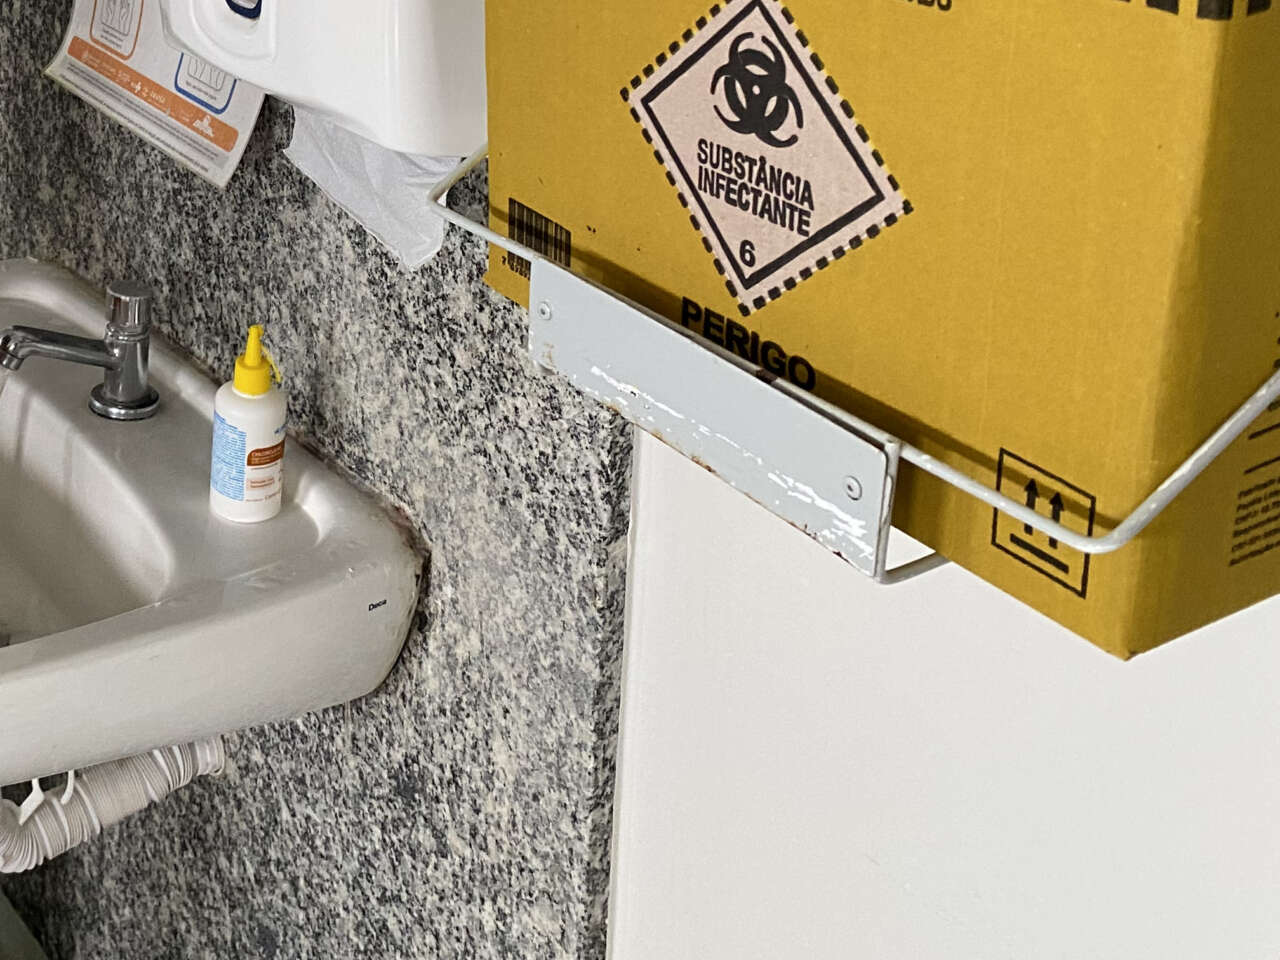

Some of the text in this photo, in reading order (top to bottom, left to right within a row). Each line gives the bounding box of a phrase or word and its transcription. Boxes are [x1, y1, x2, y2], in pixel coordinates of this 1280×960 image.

[696, 138, 815, 212] SUBSTÂNCIA
[697, 165, 812, 237] INFECTANTE
[739, 239, 756, 268] 6
[680, 295, 817, 392] PERIGO
[368, 599, 387, 611] Deca
